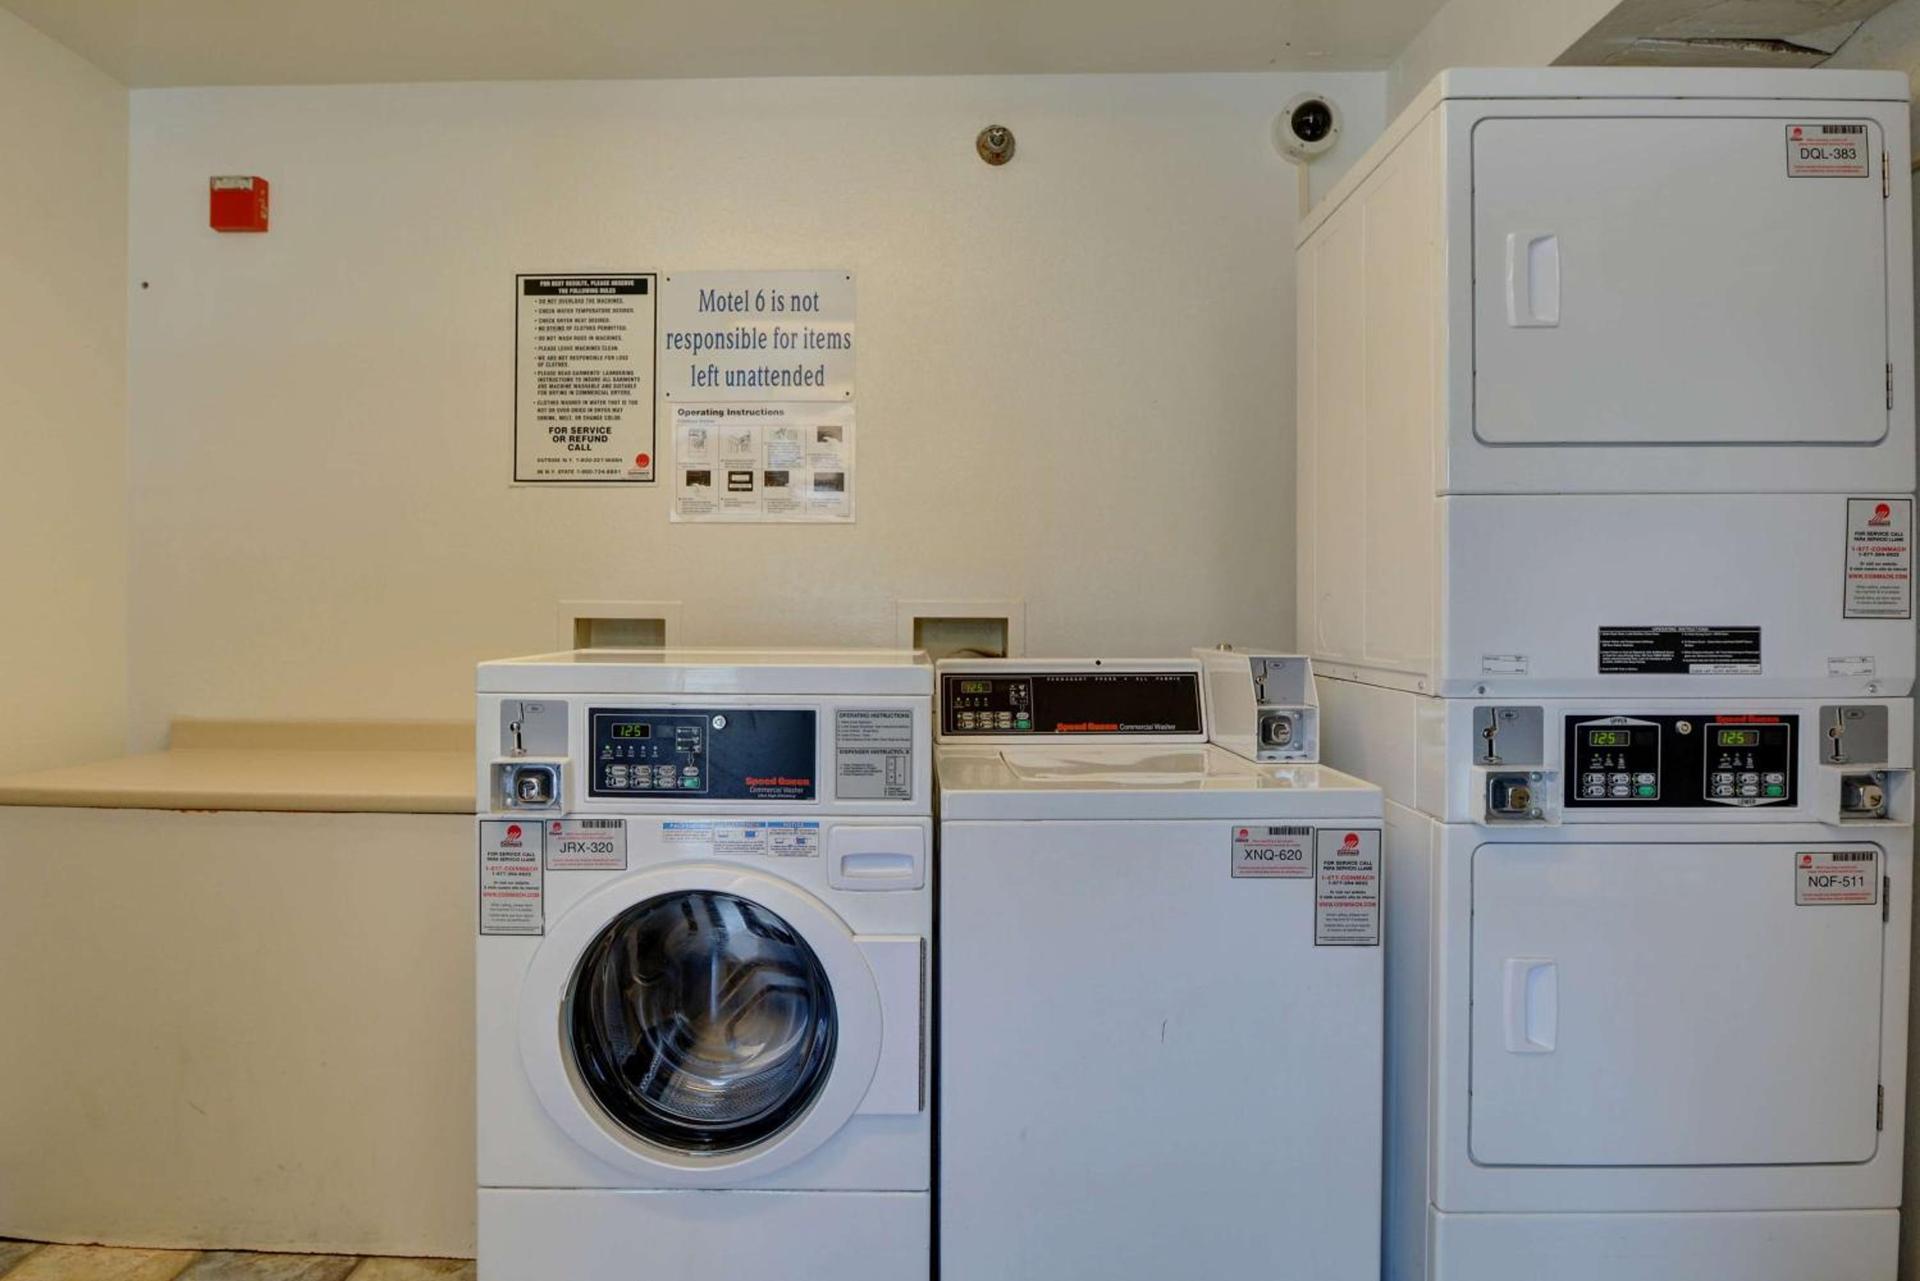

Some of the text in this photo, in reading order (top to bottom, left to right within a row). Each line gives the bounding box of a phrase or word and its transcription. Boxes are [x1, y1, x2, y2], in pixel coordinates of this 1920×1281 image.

[1800, 147, 1856, 159] DQL-383
[698, 289, 819, 312] Motel 6 is not
[666, 327, 851, 355] responsible for items
[691, 364, 824, 387] left unattended
[678, 408, 784, 417] Operating Instructions
[552, 435, 608, 443] OR REFUND
[568, 443, 592, 451] CALL
[619, 726, 641, 737] 125
[1594, 733, 1616, 744] 125
[1723, 733, 1744, 744] 125
[560, 842, 613, 853] JRX-320
[1244, 849, 1302, 860] XNQ-620
[1808, 876, 1864, 887] NQF-511
